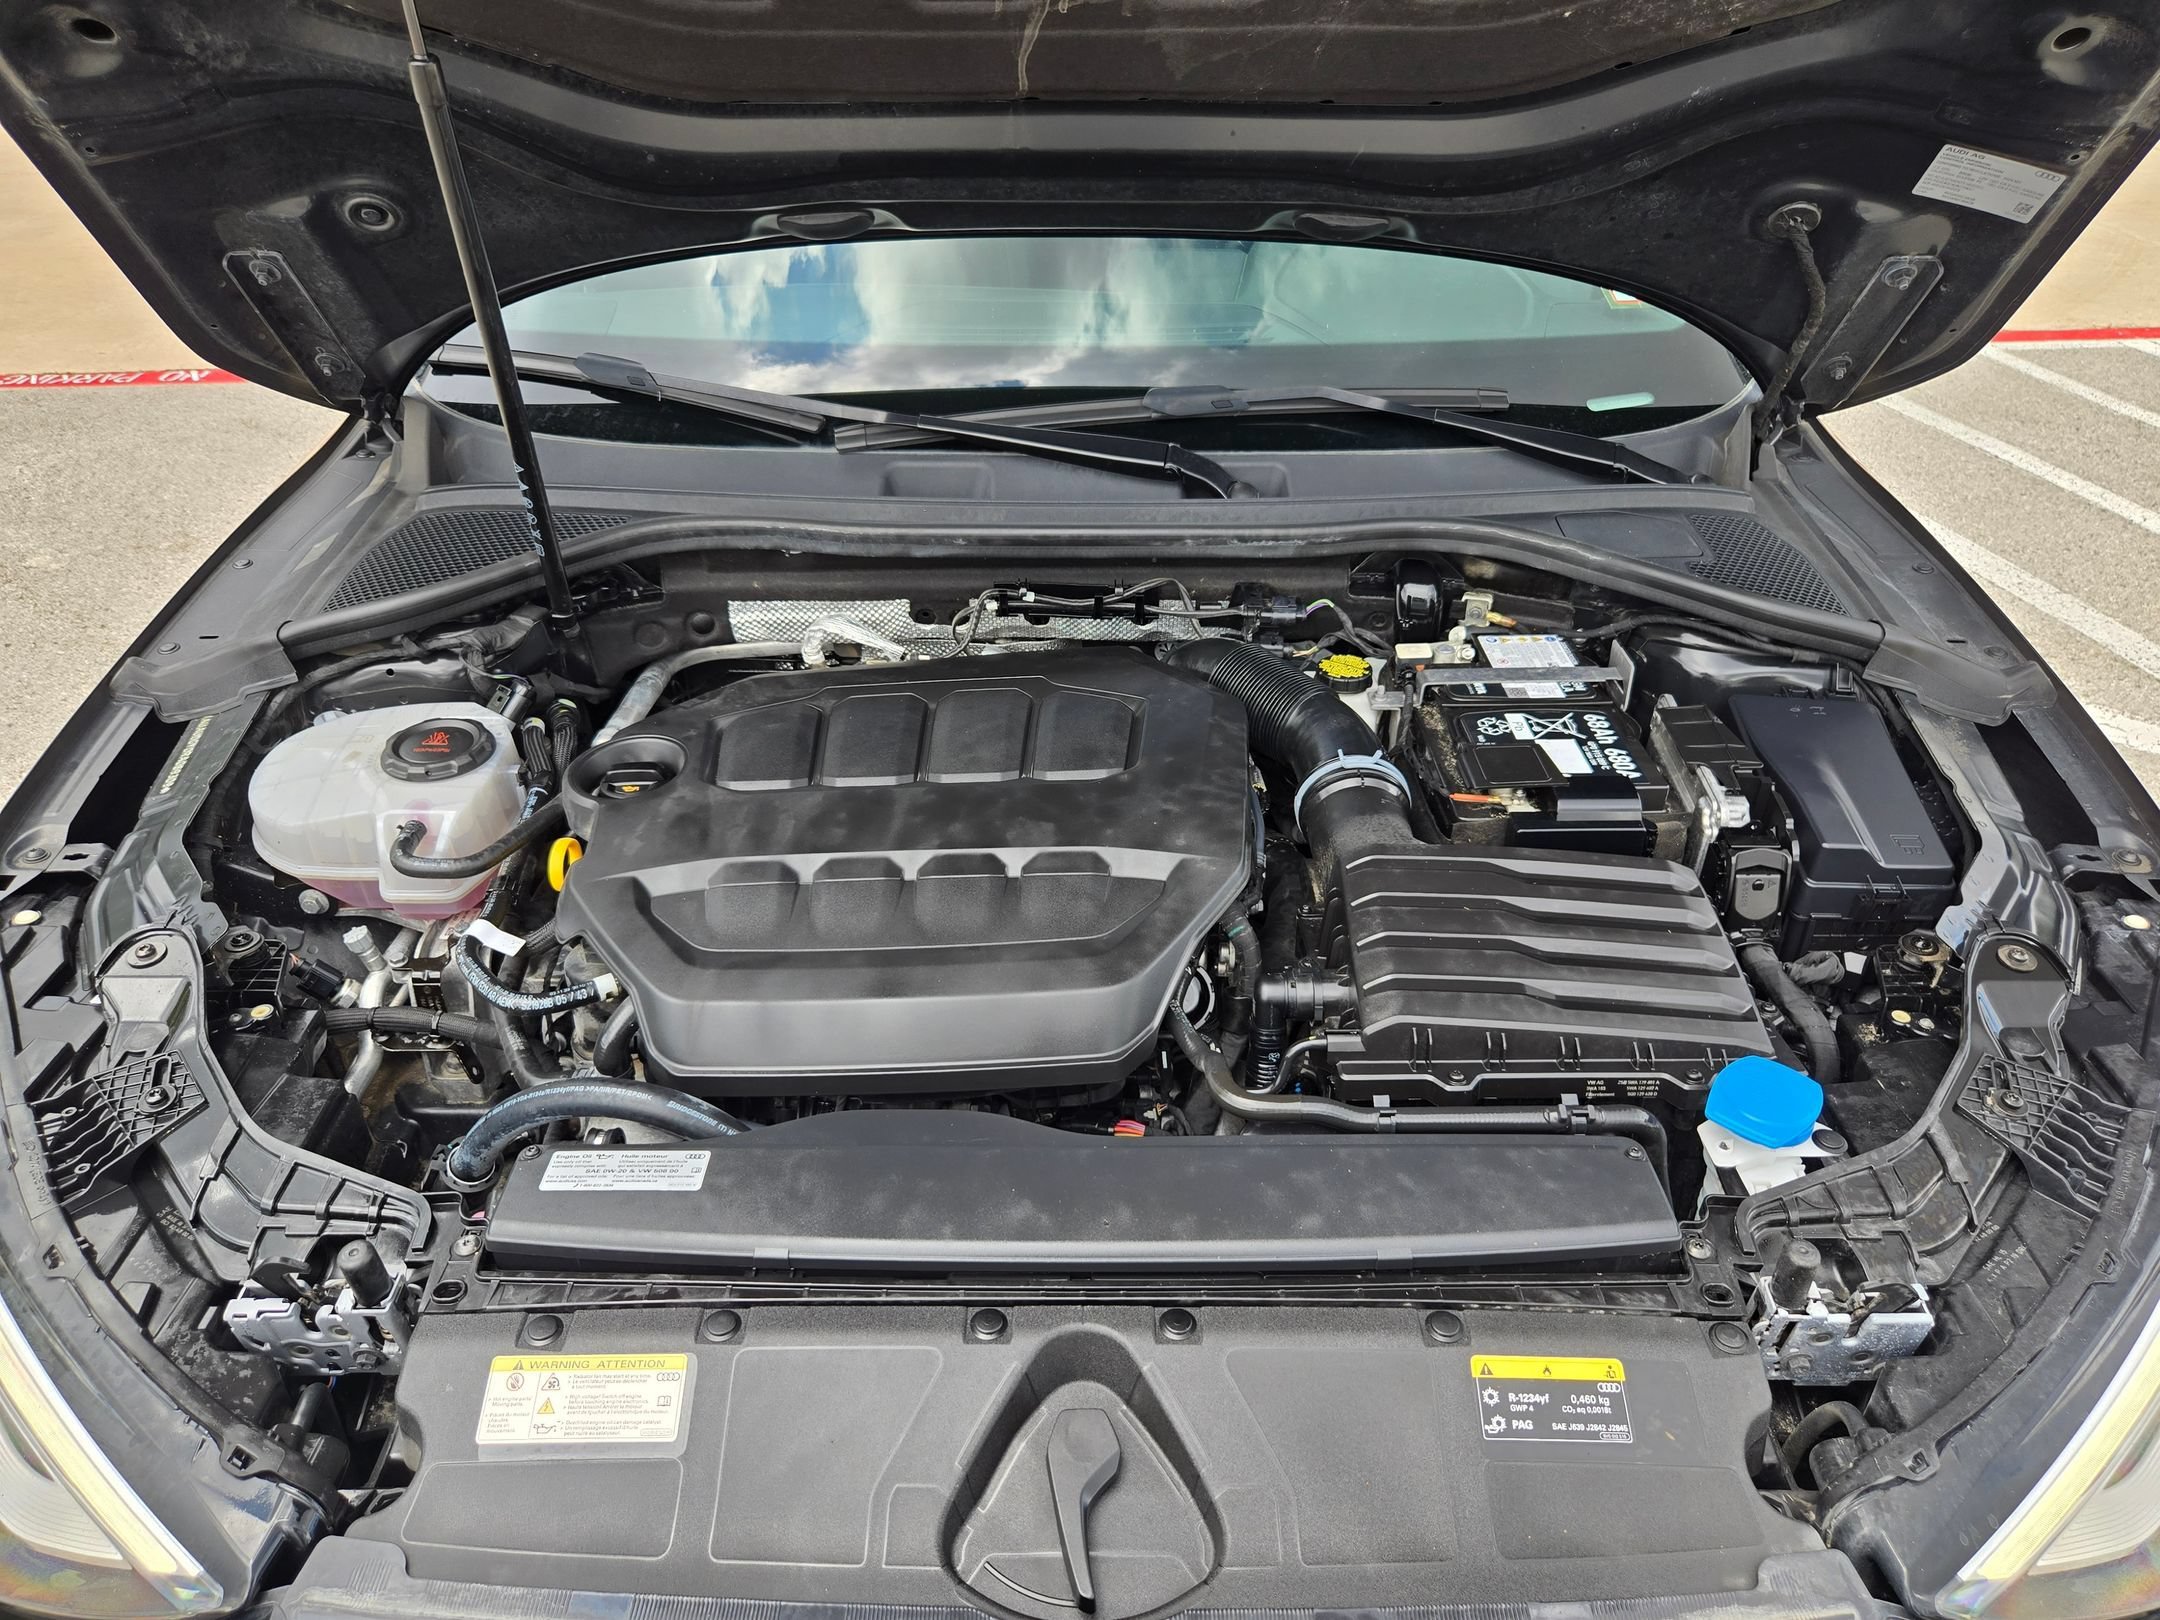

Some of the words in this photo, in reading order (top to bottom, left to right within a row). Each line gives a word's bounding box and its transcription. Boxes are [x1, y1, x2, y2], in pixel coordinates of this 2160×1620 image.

[1944, 145, 1969, 156] AUDI
[1968, 152, 1986, 160] AG
[0, 372, 145, 385] PARKING
[159, 369, 211, 382] NO
[1583, 714, 1619, 745] 68Ah
[1603, 748, 1643, 779] 680A
[666, 1100, 718, 1127] BRIDGESTONE
[528, 1360, 590, 1368] WARNING
[596, 1359, 666, 1368] ATTENTION
[1508, 1393, 1549, 1405] R-1234yf
[1571, 1395, 1597, 1404] 0,460
[1599, 1394, 1610, 1406] kg
[1577, 1407, 1586, 1415] eq
[1512, 1419, 1533, 1430] PAG
